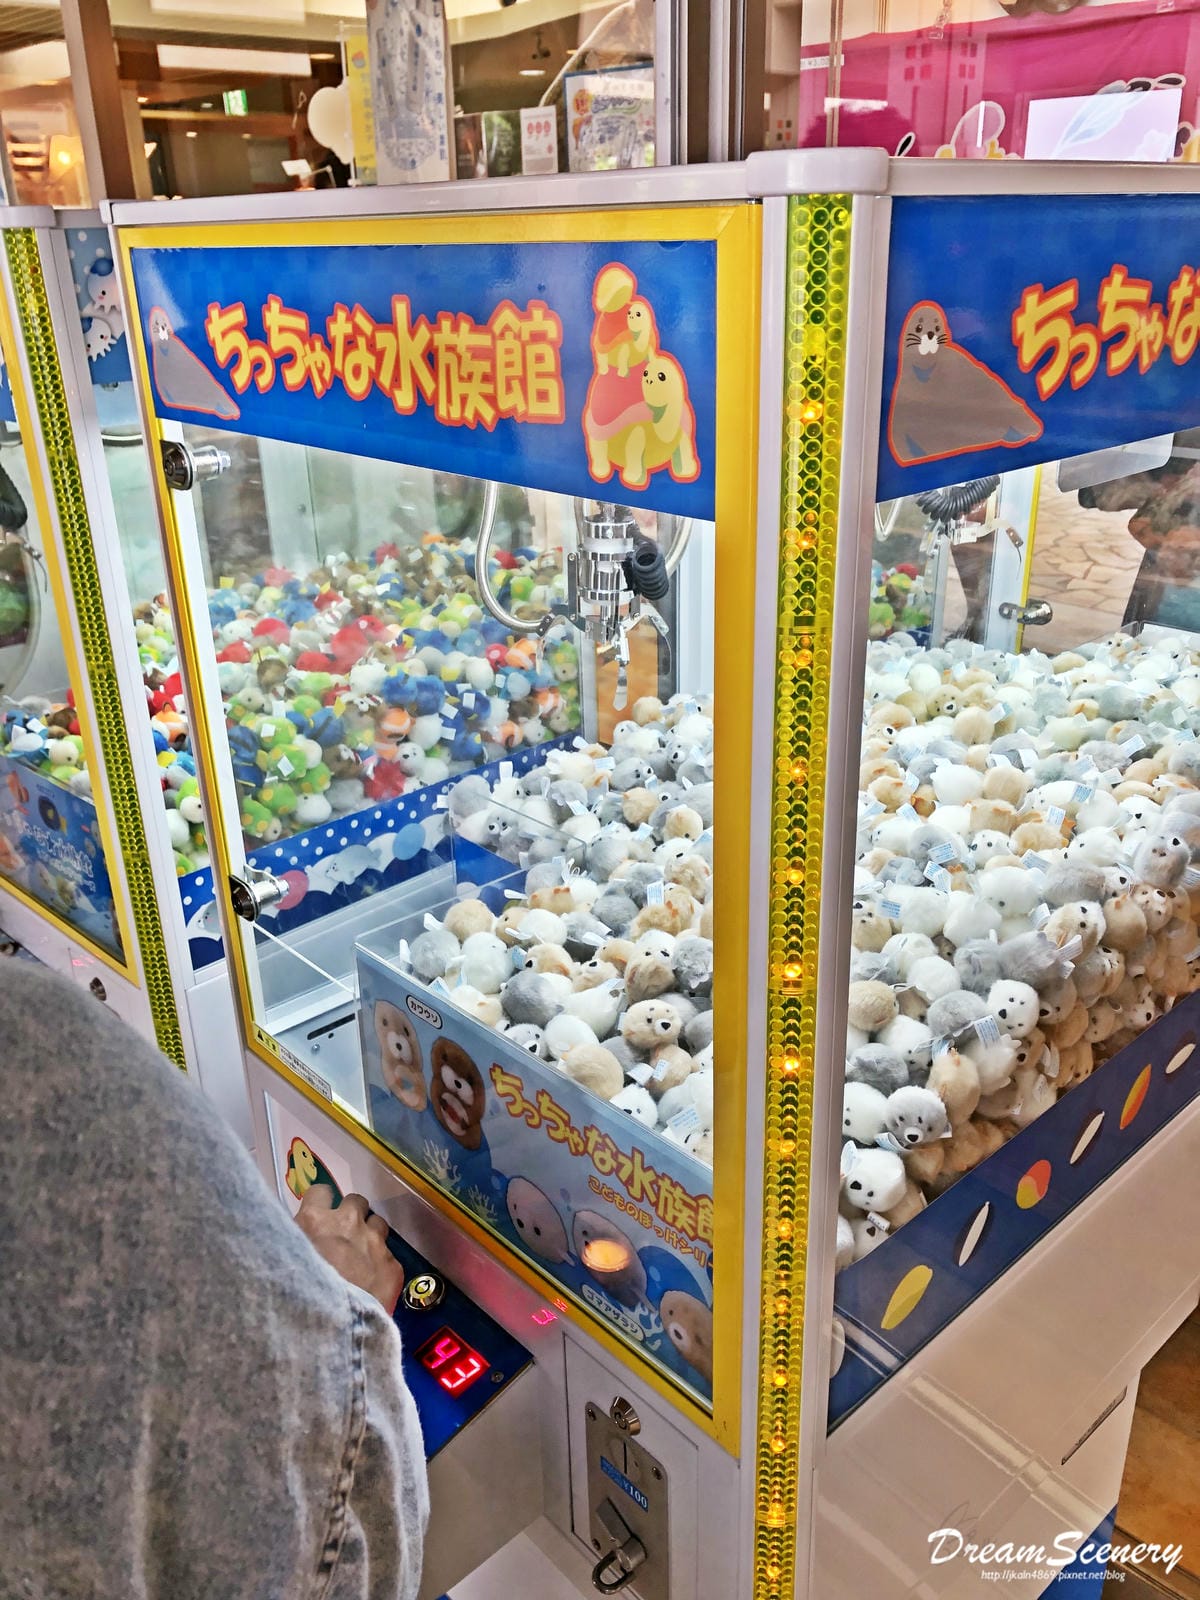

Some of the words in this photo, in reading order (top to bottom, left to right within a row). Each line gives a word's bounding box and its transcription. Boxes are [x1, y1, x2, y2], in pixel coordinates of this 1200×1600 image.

[205, 294, 565, 432] ちっちゃな水族館
